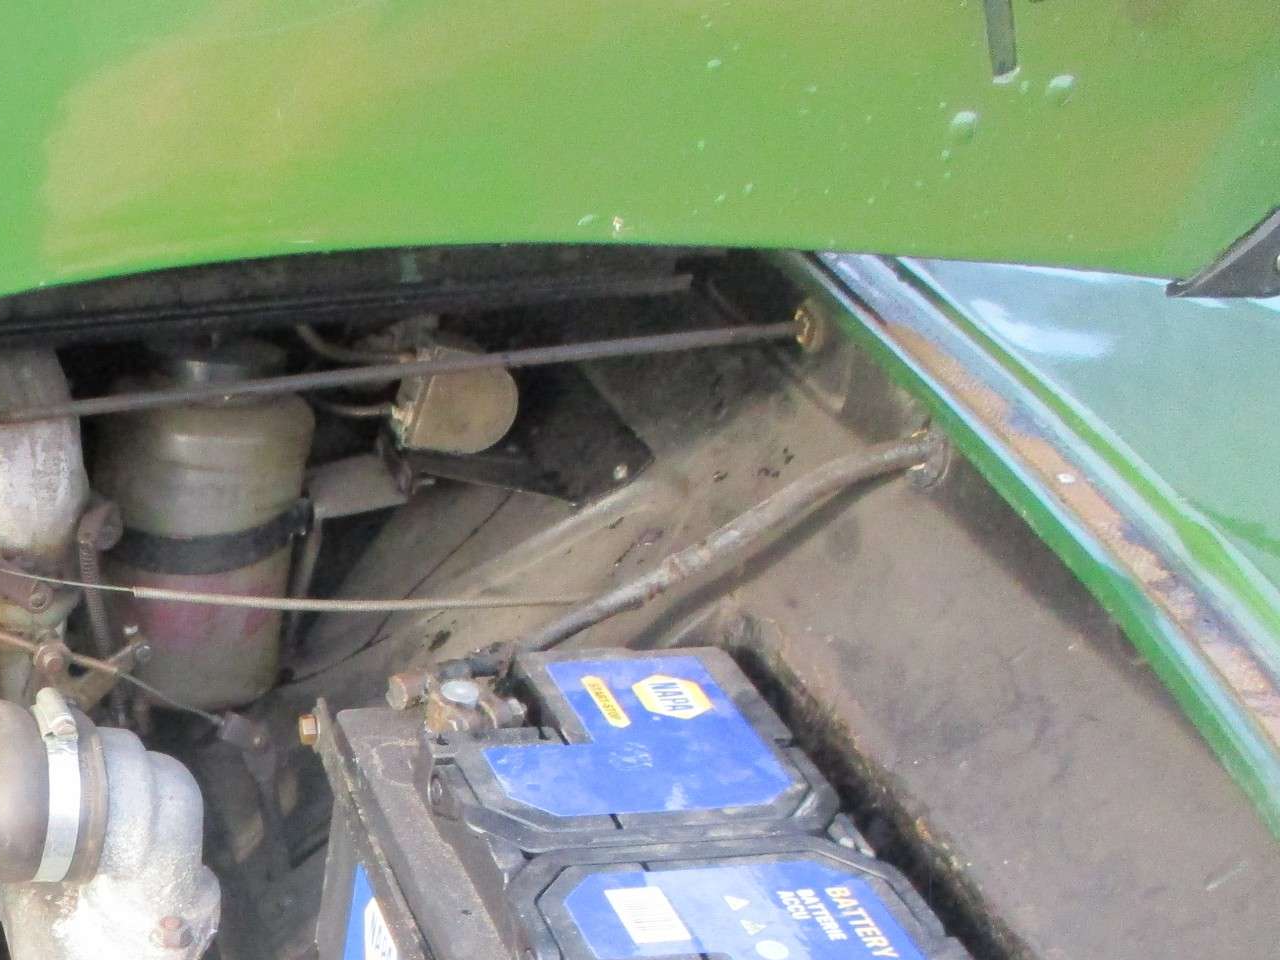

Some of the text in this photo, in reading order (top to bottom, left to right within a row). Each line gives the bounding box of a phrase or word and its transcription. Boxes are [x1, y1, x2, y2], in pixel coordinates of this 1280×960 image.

[648, 682, 694, 712] NAPA
[776, 890, 812, 920] ACCU
[795, 888, 848, 941] BATTERIE
[824, 886, 900, 957] BATTERY
